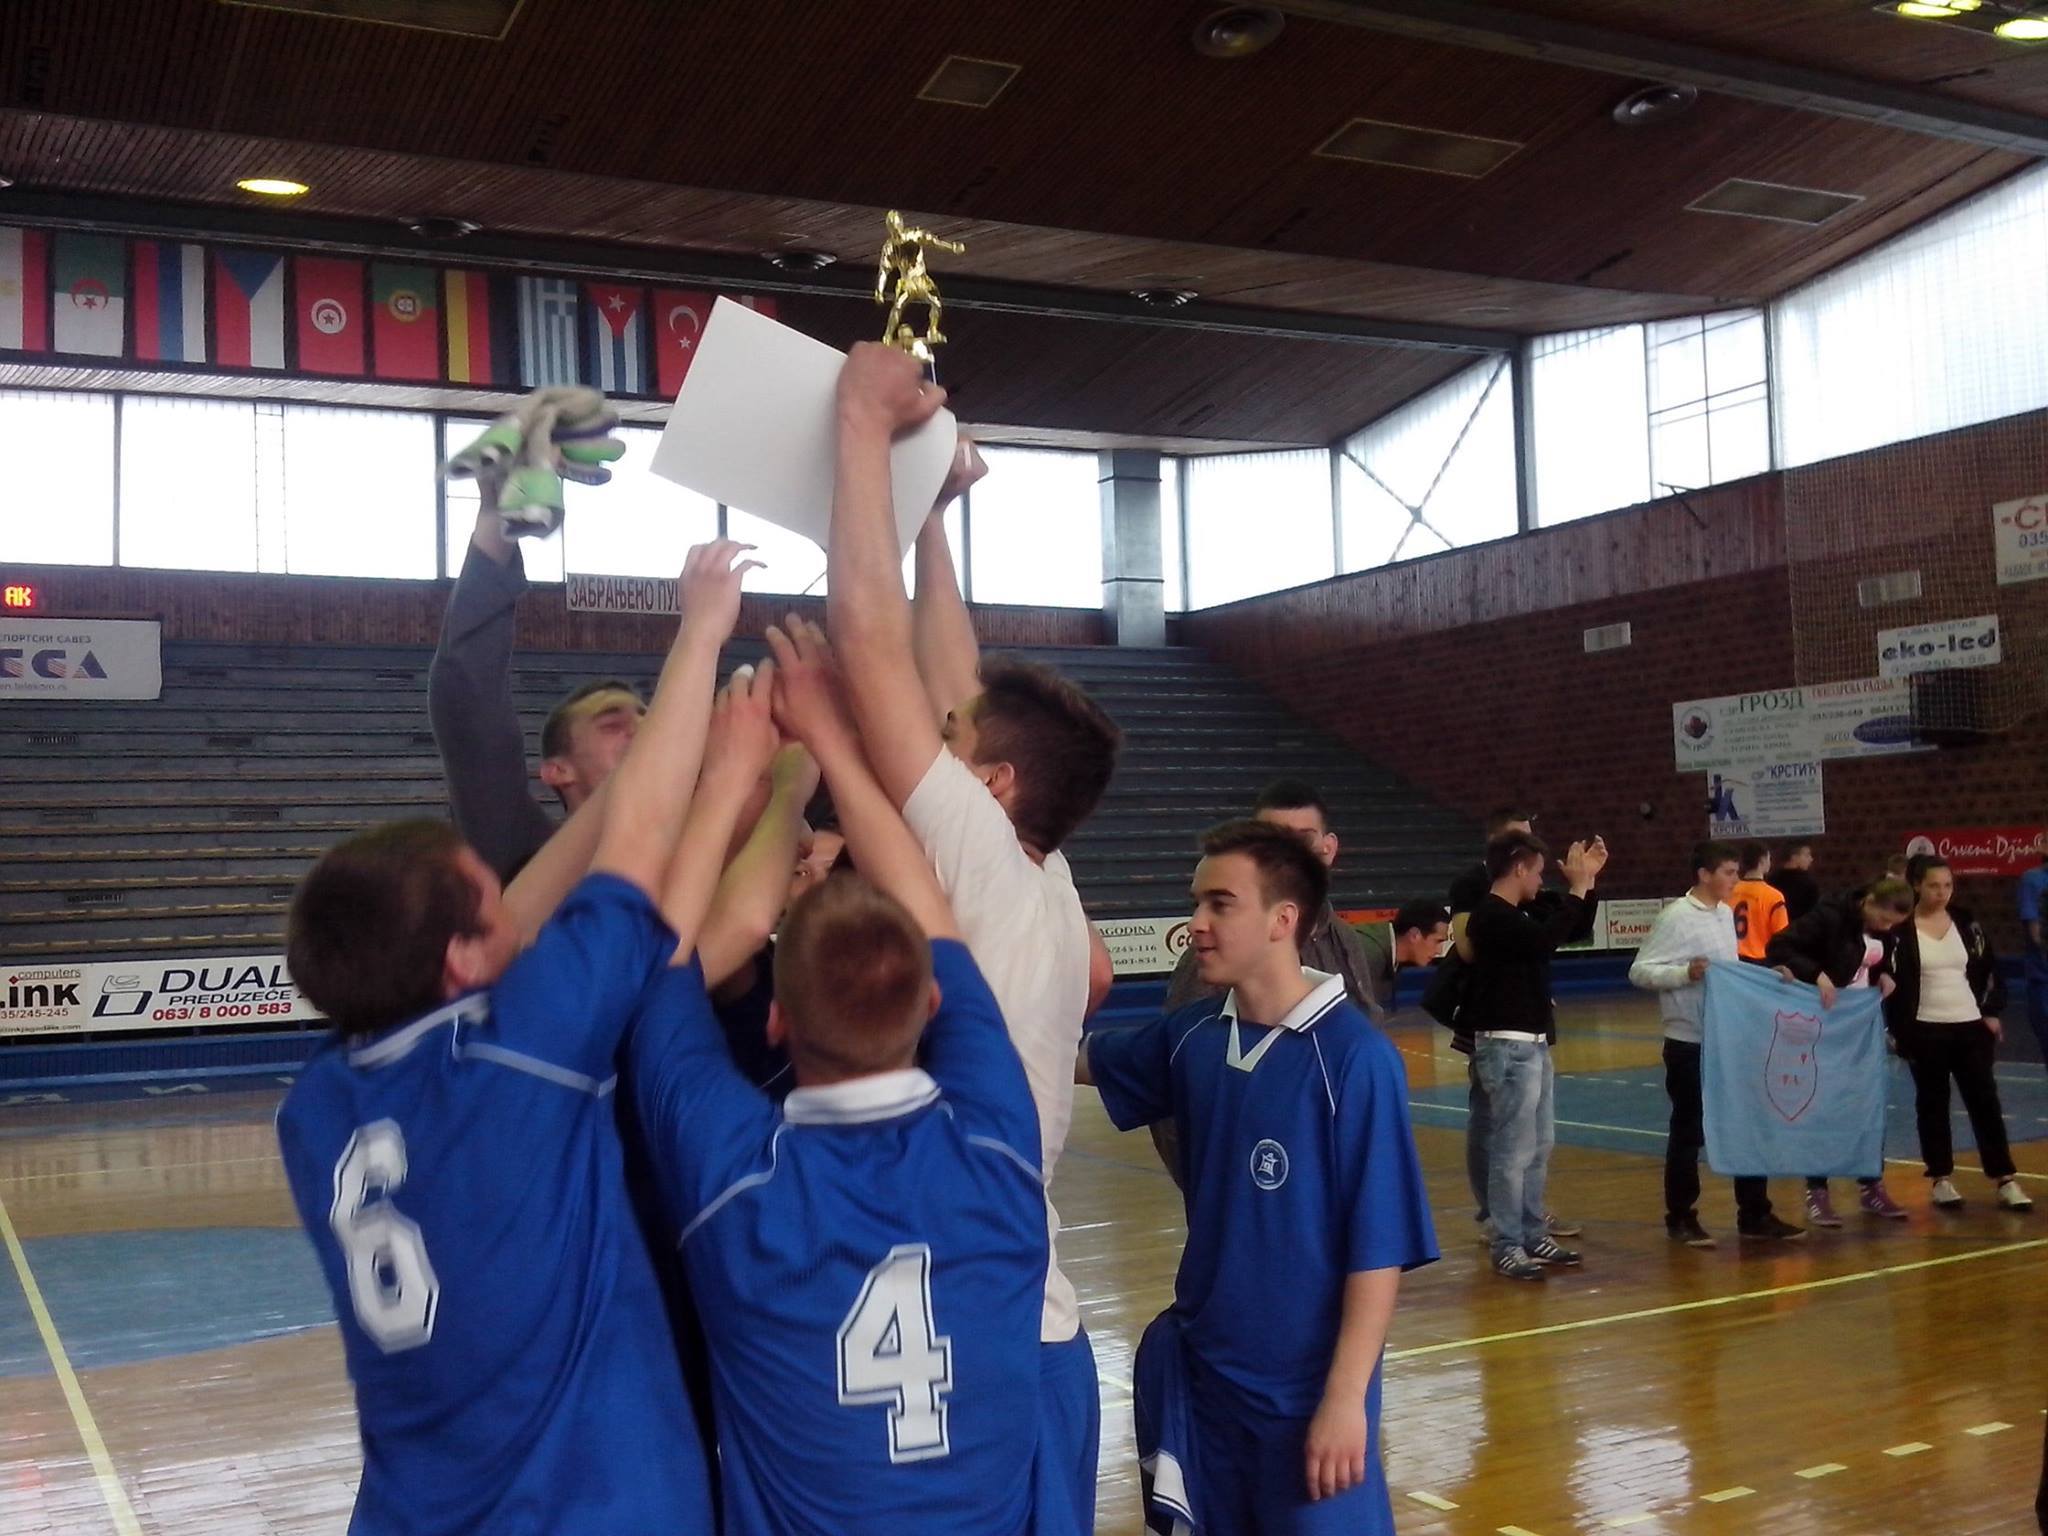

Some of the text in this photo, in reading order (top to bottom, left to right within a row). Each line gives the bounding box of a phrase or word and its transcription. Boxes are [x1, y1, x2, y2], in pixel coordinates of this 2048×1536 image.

[570, 576, 655, 610] ЗАБРАЊЕНО
[1740, 690, 1805, 712] ГРОЗД
[1732, 900, 1749, 939] 6
[18, 969, 81, 980] computers
[159, 964, 293, 994] DUAL
[153, 1002, 292, 1021] 063/ 8 000 583
[169, 989, 292, 1006] PREDUZEĆE
[329, 1117, 440, 1354] 6
[836, 1243, 953, 1463] 4
